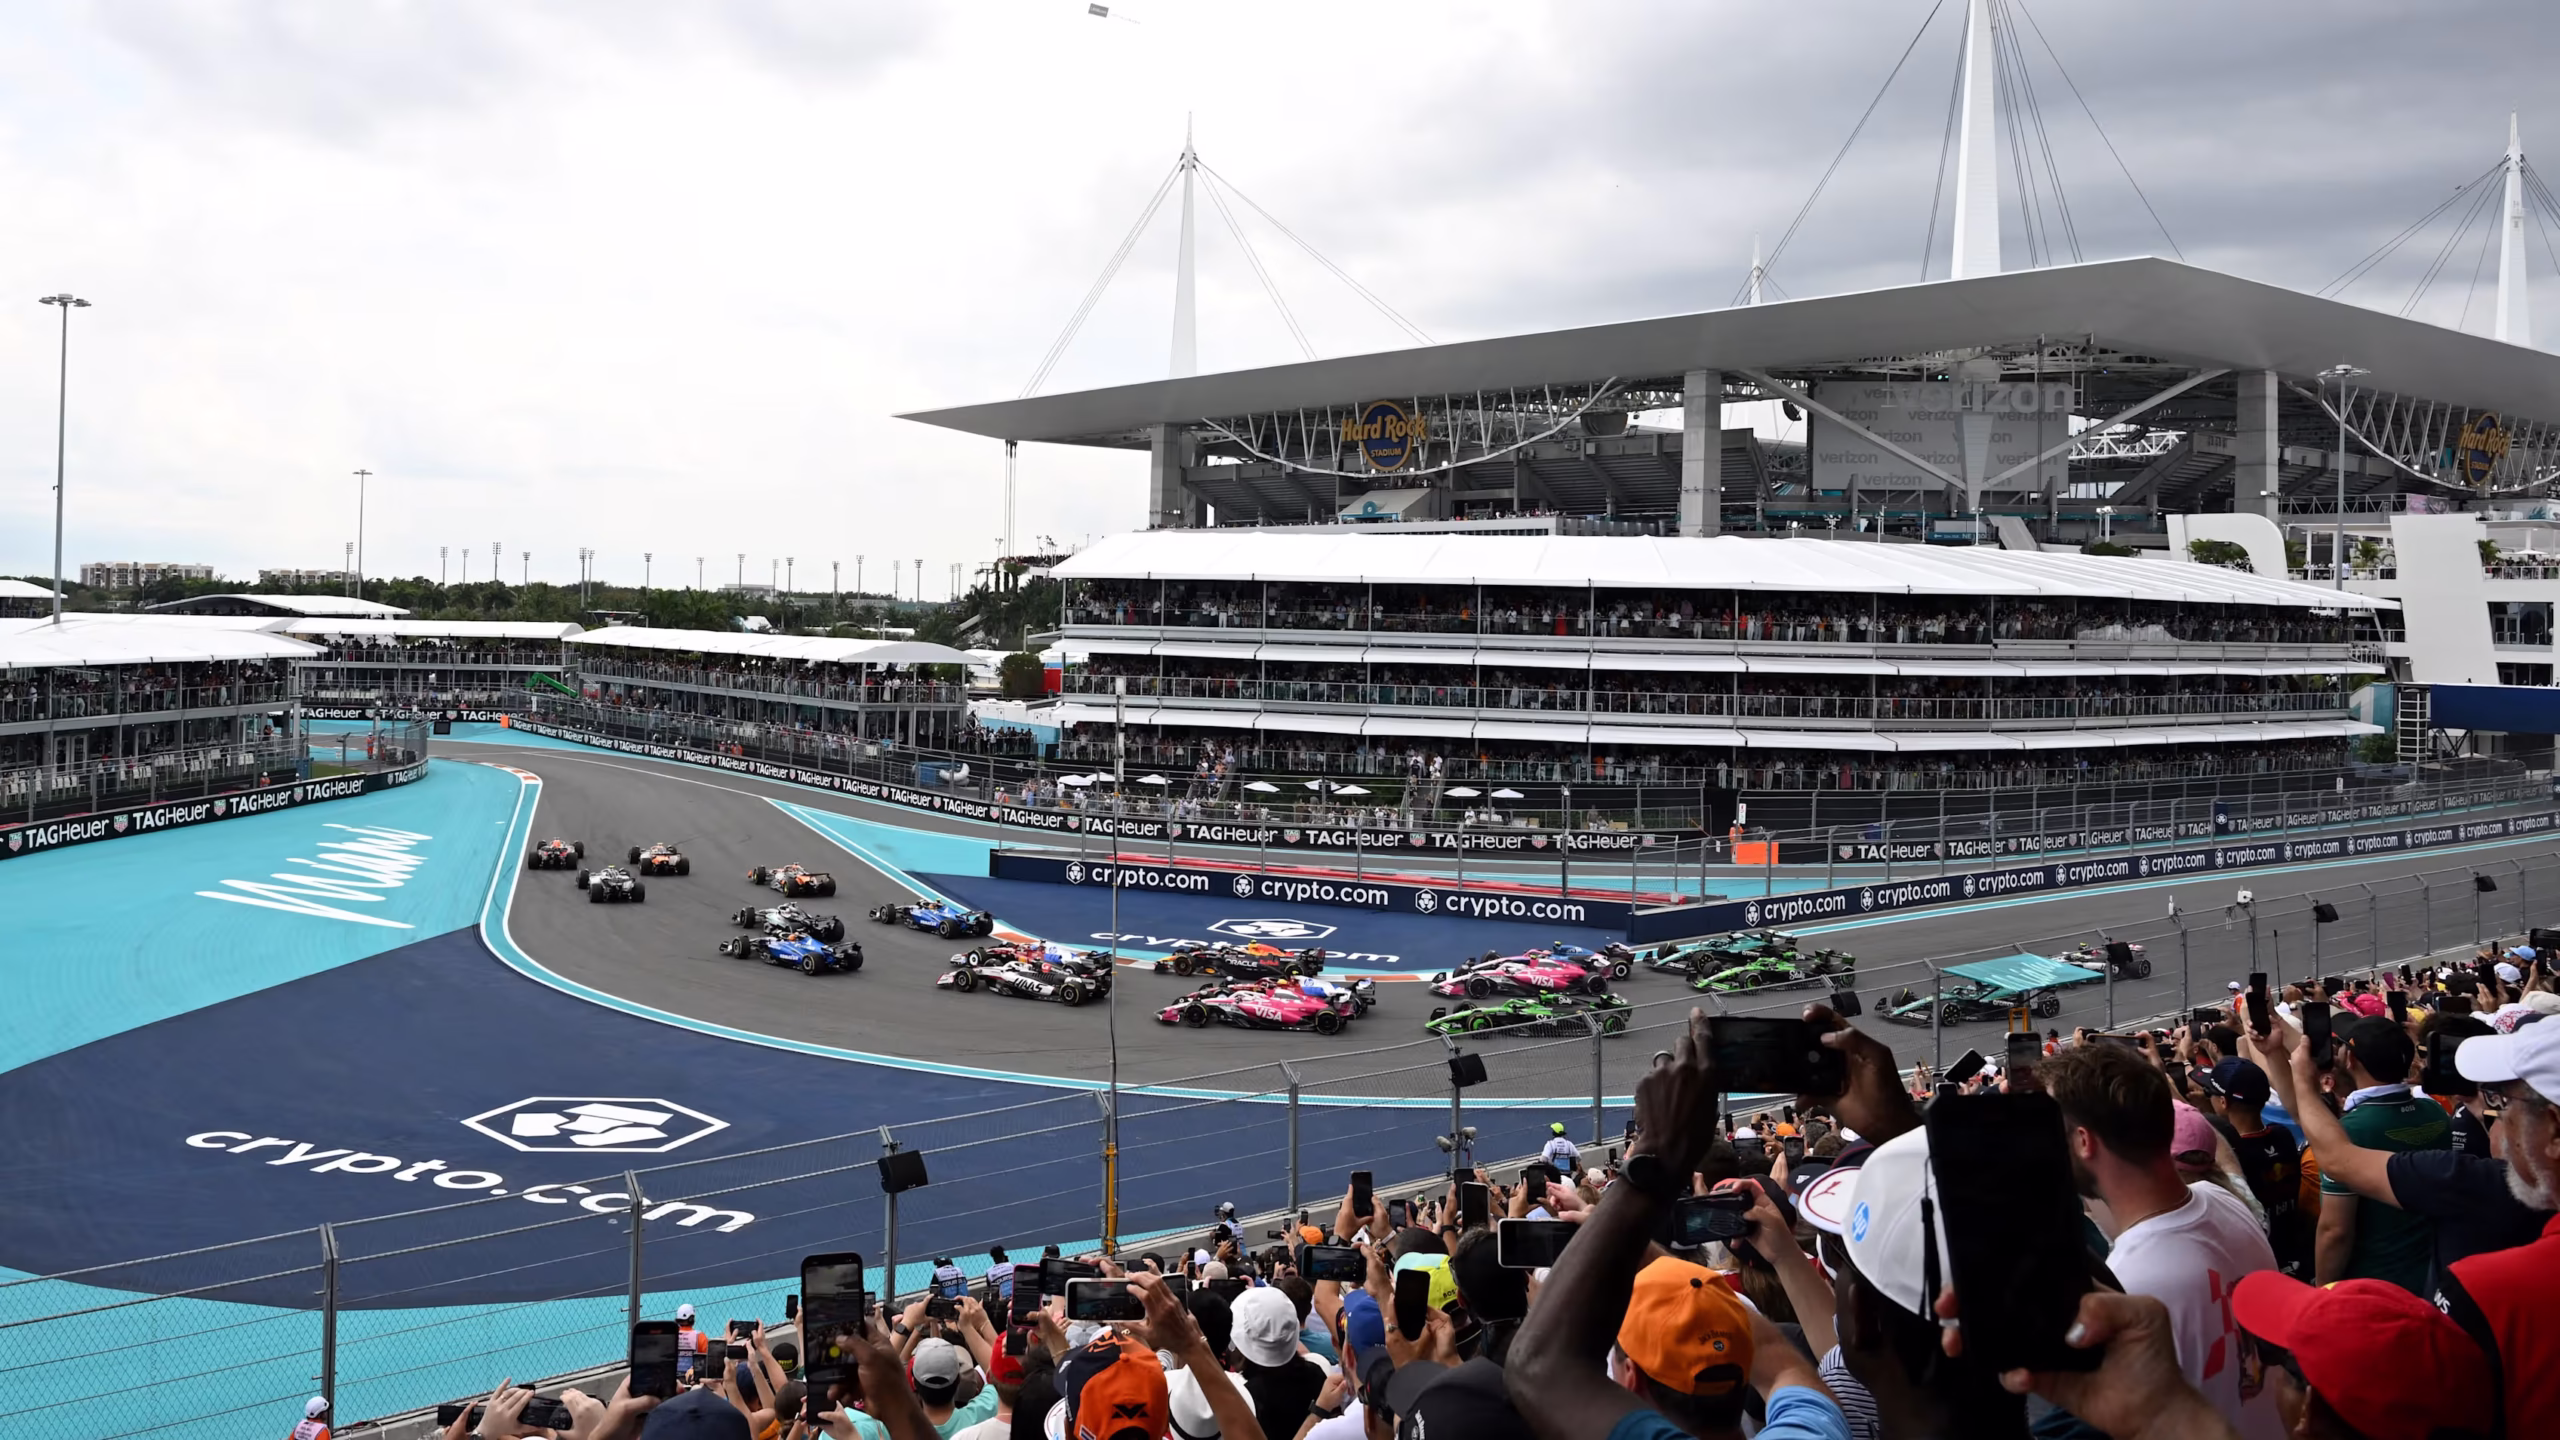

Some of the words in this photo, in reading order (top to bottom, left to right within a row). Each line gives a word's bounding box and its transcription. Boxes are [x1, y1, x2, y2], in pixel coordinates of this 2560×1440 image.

[1341, 416, 1382, 442] Hard
[1385, 412, 1426, 442] Rock
[2460, 423, 2488, 450] Hard
[2486, 427, 2511, 458] Rock
[1370, 447, 1402, 457] STADIUM
[1819, 451, 1878, 464] verizon
[1863, 473, 1922, 486] verizon
[133, 803, 210, 830] TAGHeuer
[26, 819, 109, 848] TAGHeuer
[2356, 835, 2398, 851] crypto.com
[2414, 829, 2452, 845] crypto.com
[2227, 847, 2275, 865] crypto.com
[2295, 841, 2339, 858] crypto.com
[2069, 861, 2128, 882] crypto.com
[2152, 852, 2205, 873] crypto.com
[1092, 866, 1209, 891] crypto.com
[1979, 870, 2044, 893] crypto.com
[1261, 880, 1388, 905] crypto.com
[1878, 881, 1950, 906] crypto.com
[1446, 895, 1585, 921] crypto.com
[1765, 895, 1845, 921] crypto.com
[1225, 958, 1258, 968] ORACLE
[1530, 975, 1554, 988] VISA
[1254, 1007, 1282, 1021] VISA
[2401, 1104, 2416, 1113] BOSS
[185, 1130, 755, 1233] crypto.com
[1853, 1201, 1868, 1241] hp
